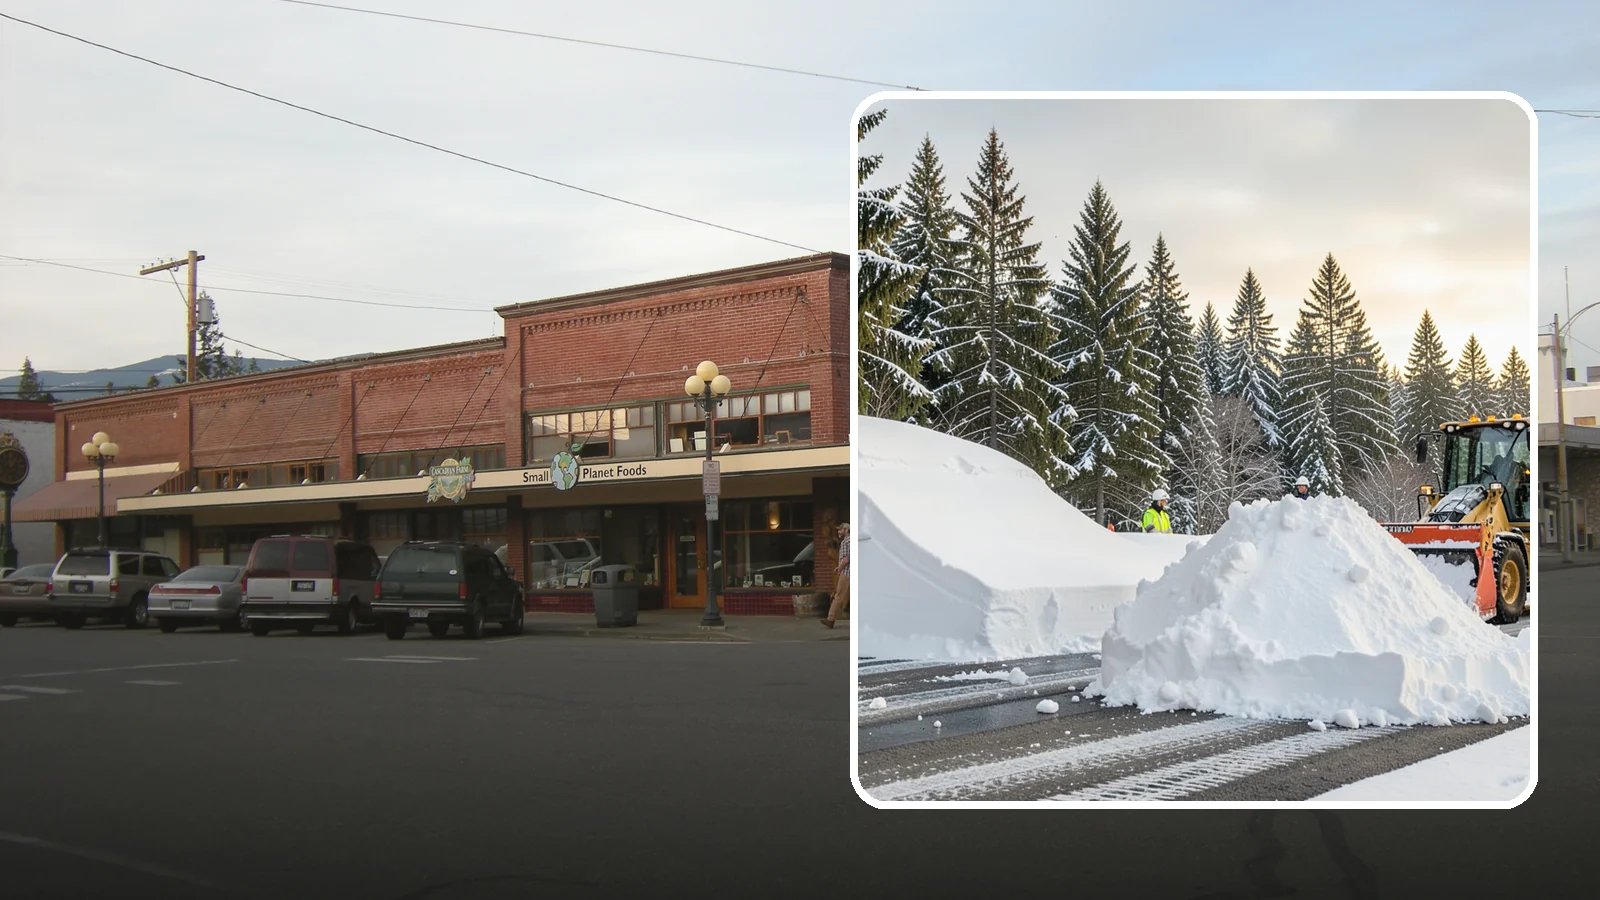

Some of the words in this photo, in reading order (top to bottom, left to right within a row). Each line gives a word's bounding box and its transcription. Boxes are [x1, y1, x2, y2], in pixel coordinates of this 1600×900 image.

[523, 472, 549, 482] Small
[582, 467, 614, 479] Planet
[616, 464, 647, 476] Foods
